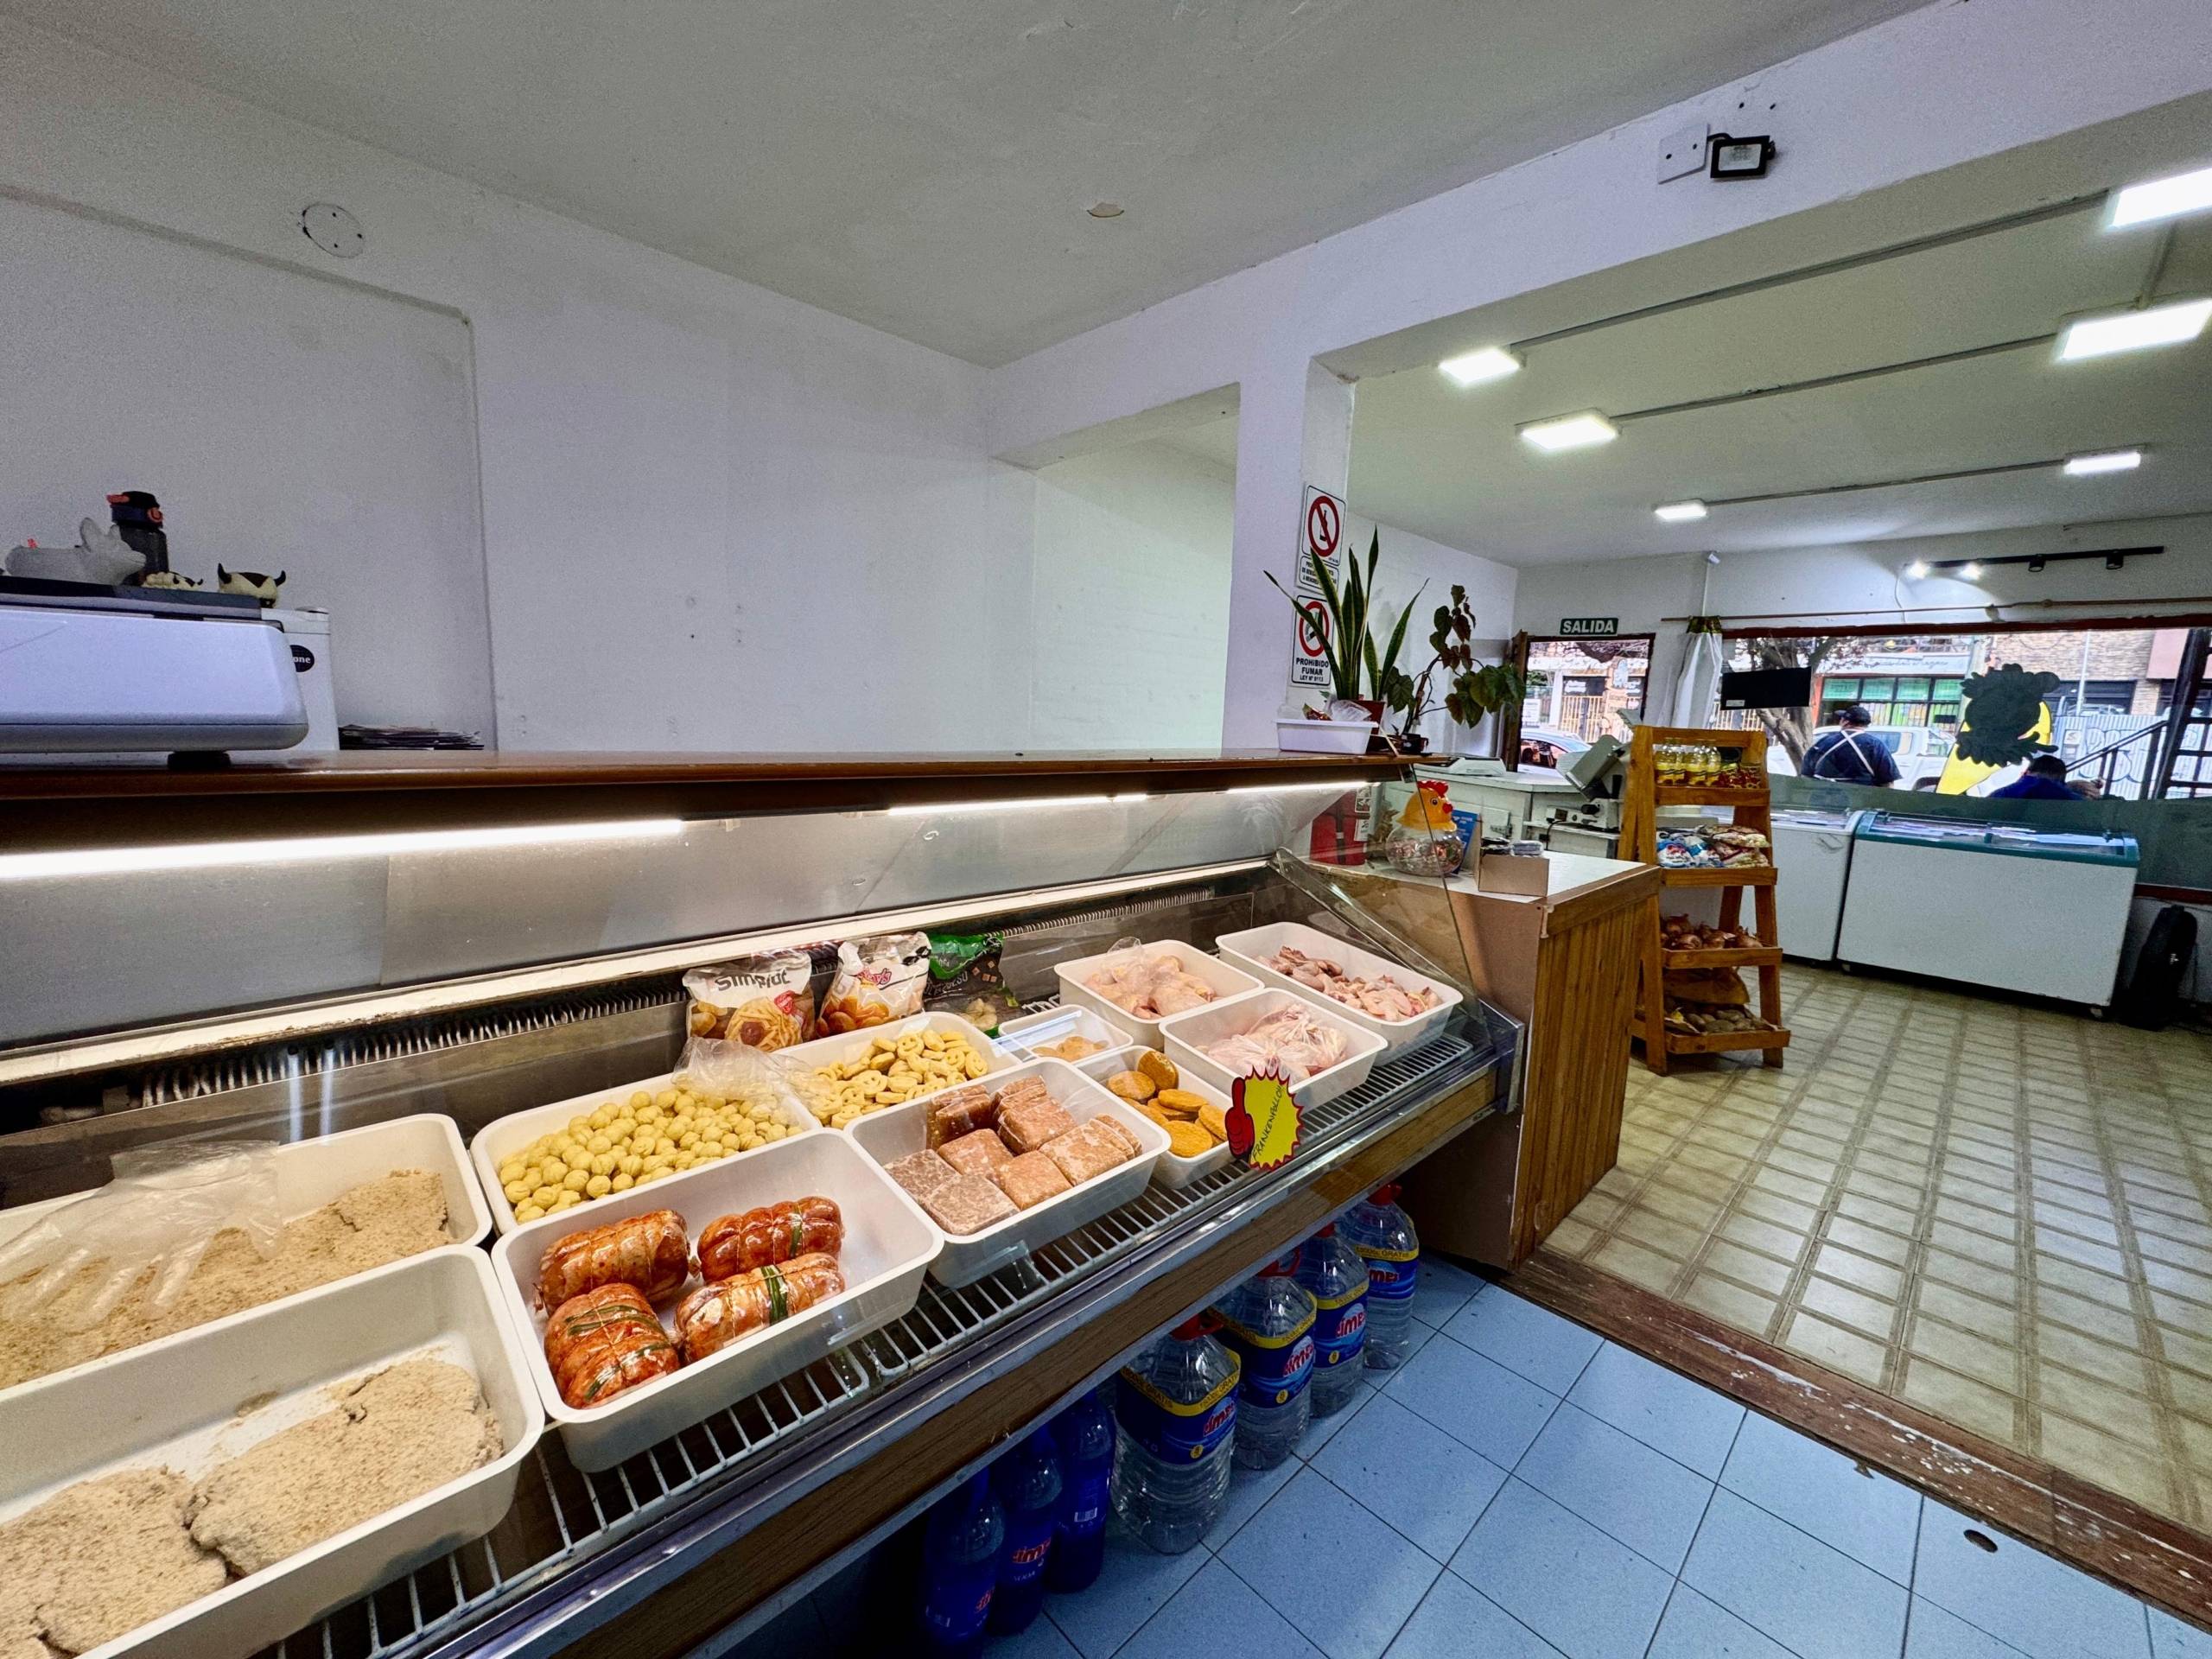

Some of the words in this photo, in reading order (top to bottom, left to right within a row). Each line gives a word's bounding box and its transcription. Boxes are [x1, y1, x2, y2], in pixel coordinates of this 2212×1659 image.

[1562, 620, 1615, 633] SALIDA
[1296, 658, 1329, 668] PROHIBIDO
[1301, 667, 1323, 676] FUMAR
[715, 969, 791, 991] Simplot
